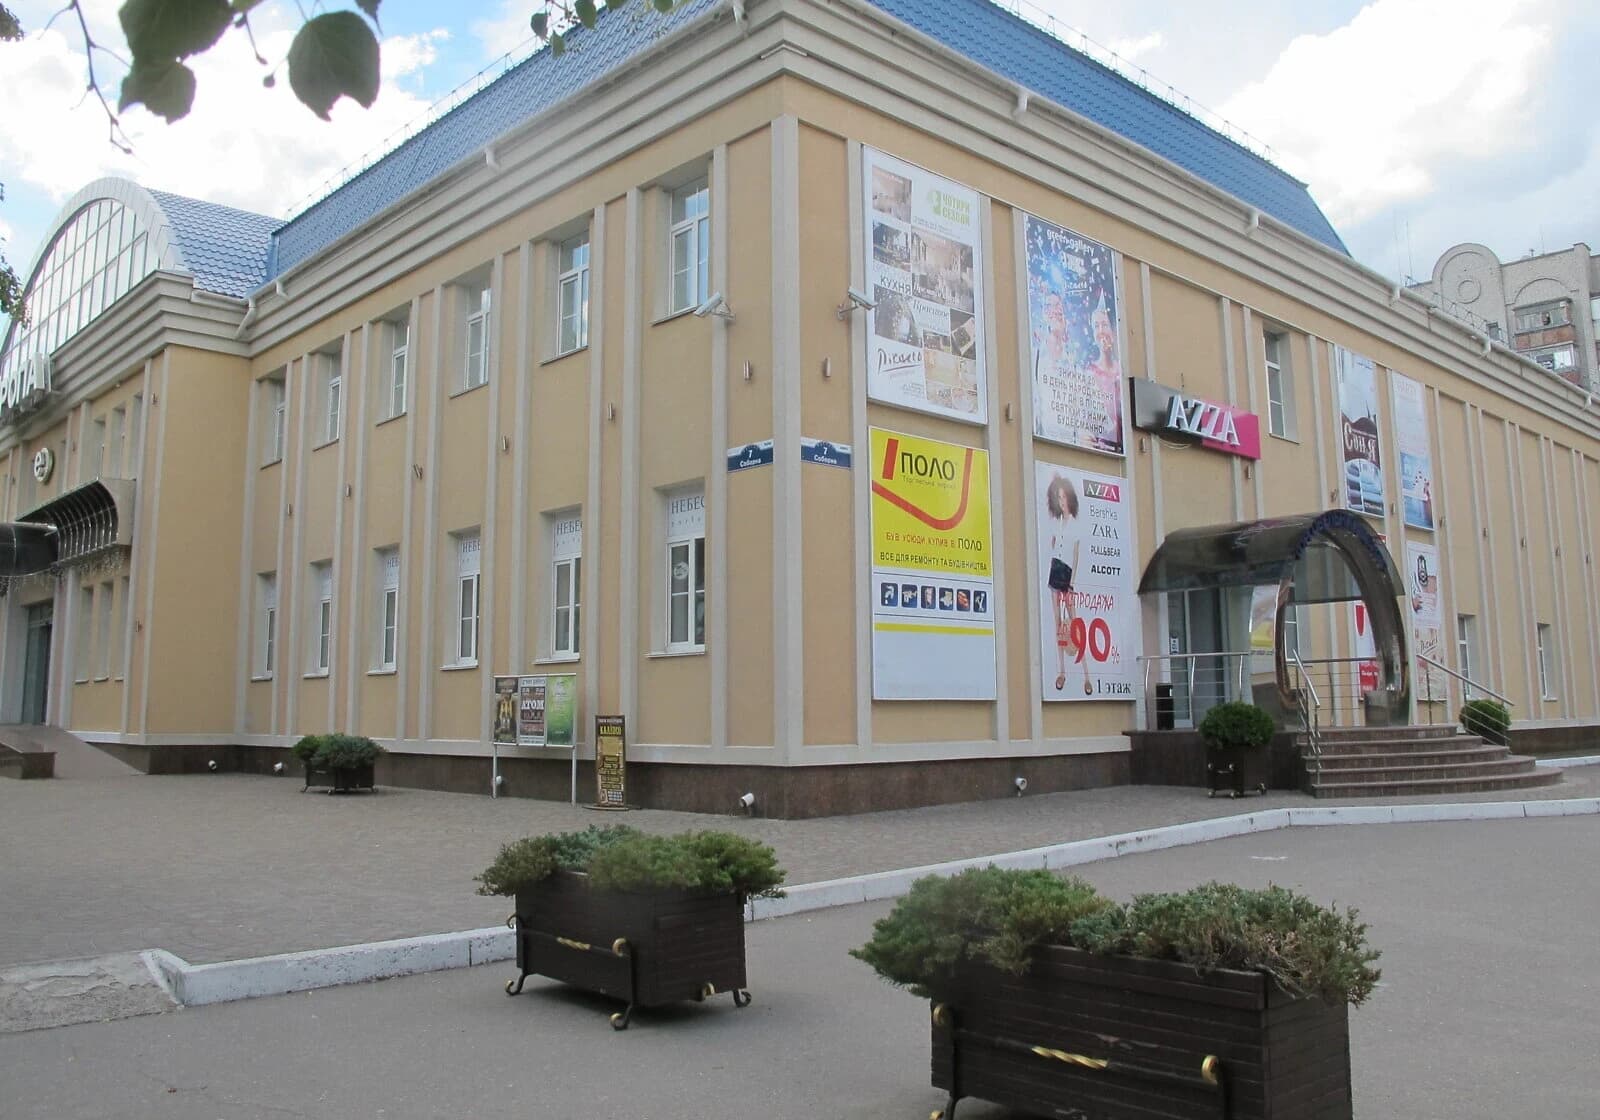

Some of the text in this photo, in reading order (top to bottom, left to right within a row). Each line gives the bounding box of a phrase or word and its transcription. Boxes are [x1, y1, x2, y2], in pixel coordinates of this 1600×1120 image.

[880, 274, 912, 296] КУХНЯ
[1166, 394, 1240, 446] AZZA
[748, 450, 753, 459] 7
[823, 446, 828, 455] 7
[901, 452, 955, 481] ПОЛО
[1086, 482, 1117, 500] AZZA
[1089, 504, 1118, 521] Bershka
[556, 519, 583, 536] НЕБЕ
[1091, 523, 1119, 540] ZARA
[957, 537, 983, 552] ПОЛО
[1090, 545, 1121, 558] PULL&BEAR
[880, 551, 987, 571] ВСЕ ДЛЯ РЕМОНТУ ТА БУДІВНИЦТВА
[1090, 564, 1121, 576] ALCOTT
[1096, 679, 1131, 694] 1 этаж
